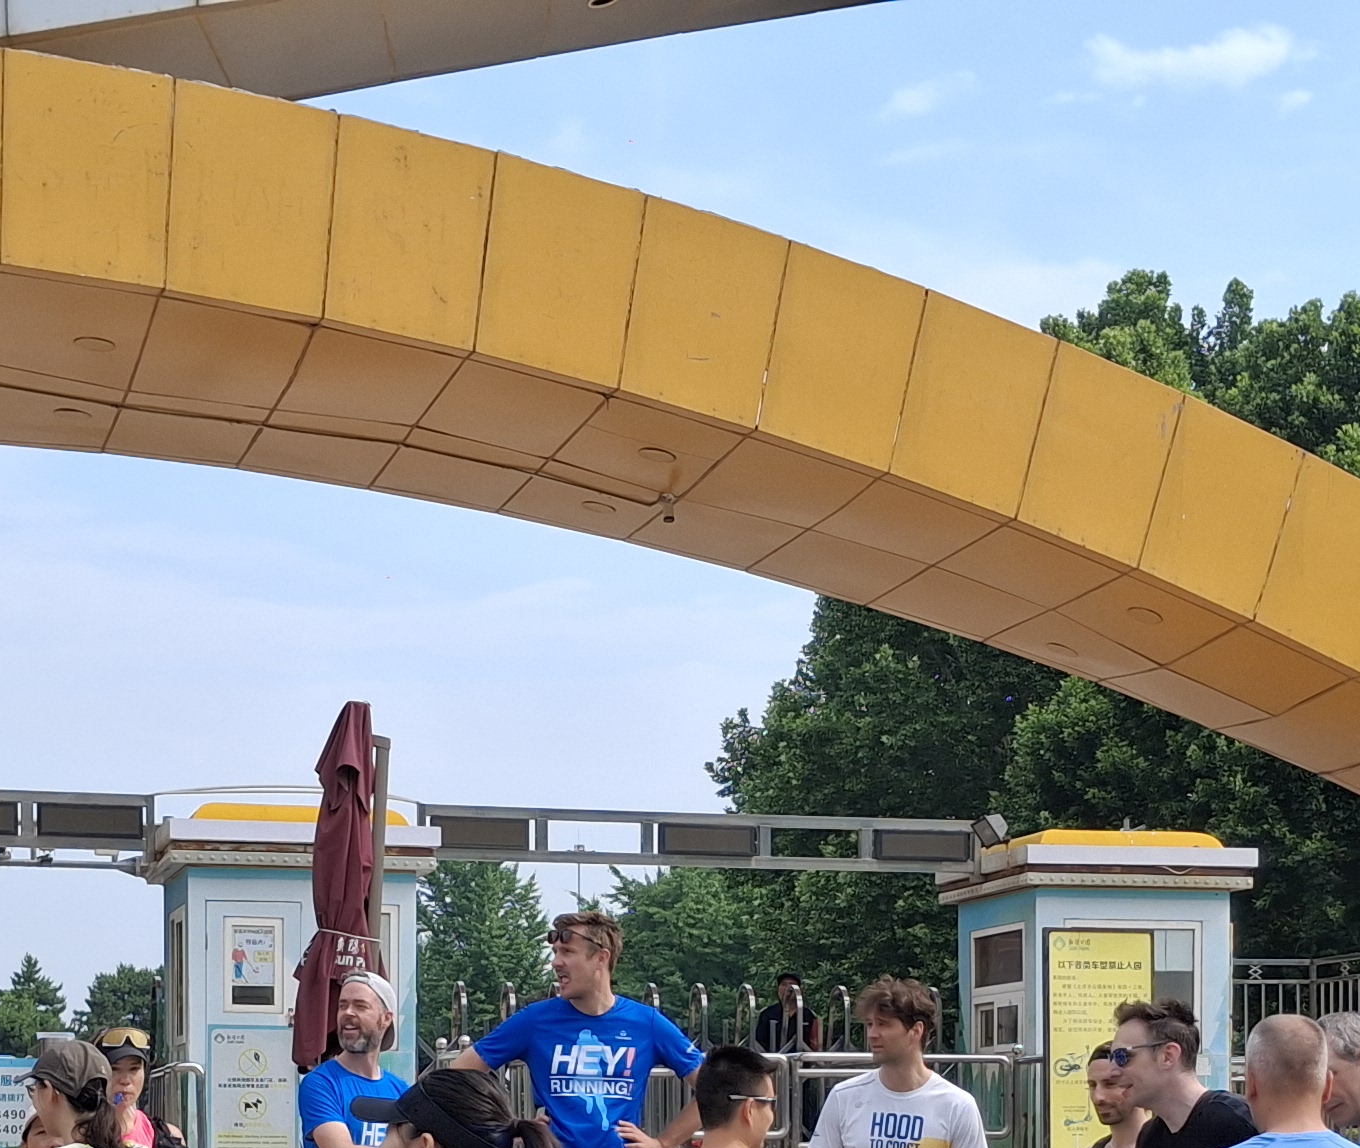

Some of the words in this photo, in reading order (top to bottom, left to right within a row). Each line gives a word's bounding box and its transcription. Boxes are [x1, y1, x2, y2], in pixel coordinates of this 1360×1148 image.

[551, 1044, 637, 1077] HEY!
[550, 1080, 635, 1096] RUNNING!
[870, 1112, 924, 1141] HOOD
